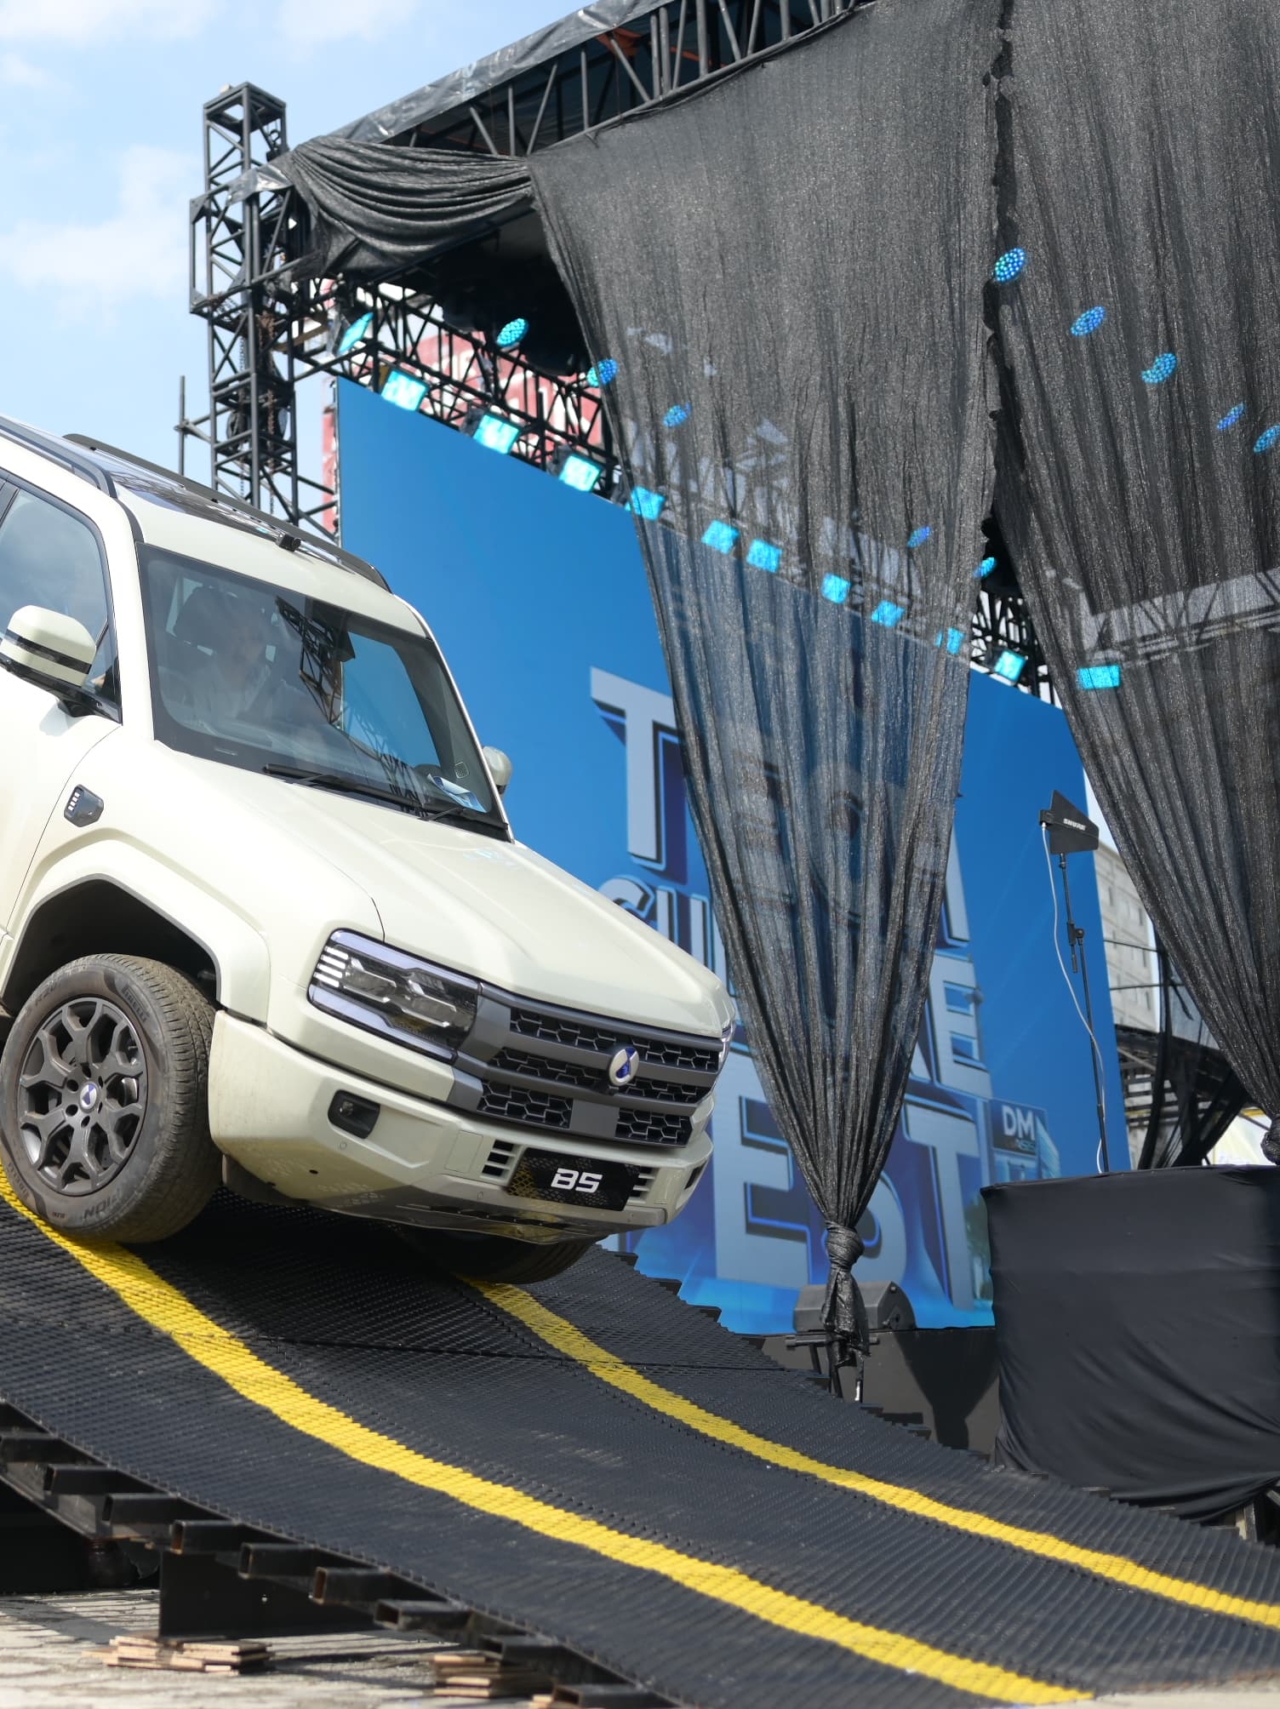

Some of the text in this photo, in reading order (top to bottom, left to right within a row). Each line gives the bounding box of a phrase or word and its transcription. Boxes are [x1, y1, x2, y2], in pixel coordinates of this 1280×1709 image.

[1001, 1104, 1036, 1141] DM
[550, 1167, 603, 1194] B5
[708, 1043, 982, 1310] EST
